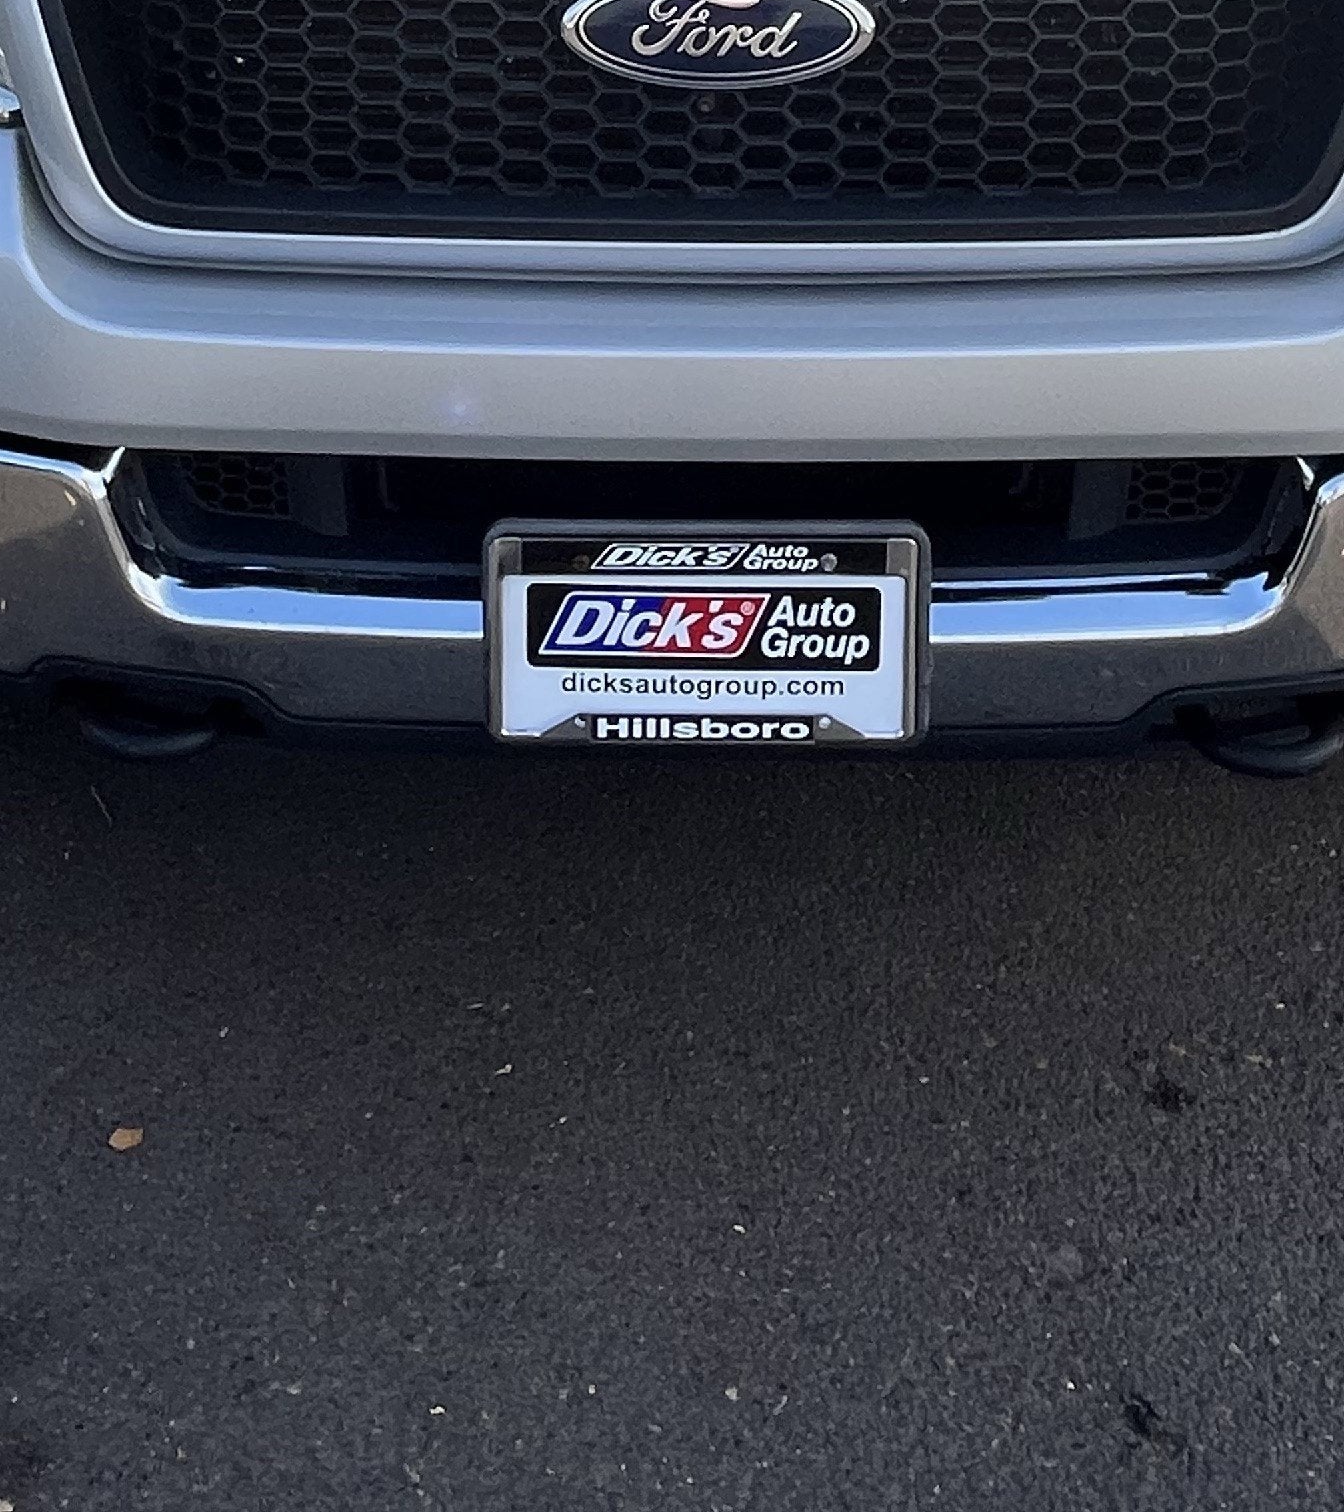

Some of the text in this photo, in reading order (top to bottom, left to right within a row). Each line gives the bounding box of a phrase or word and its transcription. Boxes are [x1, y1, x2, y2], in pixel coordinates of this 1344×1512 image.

[752, 544, 809, 558] Auto
[742, 555, 818, 572] Group
[767, 596, 856, 628] Auto
[760, 627, 871, 665] Group
[561, 673, 845, 699] dicksautogroup.com
[596, 717, 810, 739] Hillsboro
